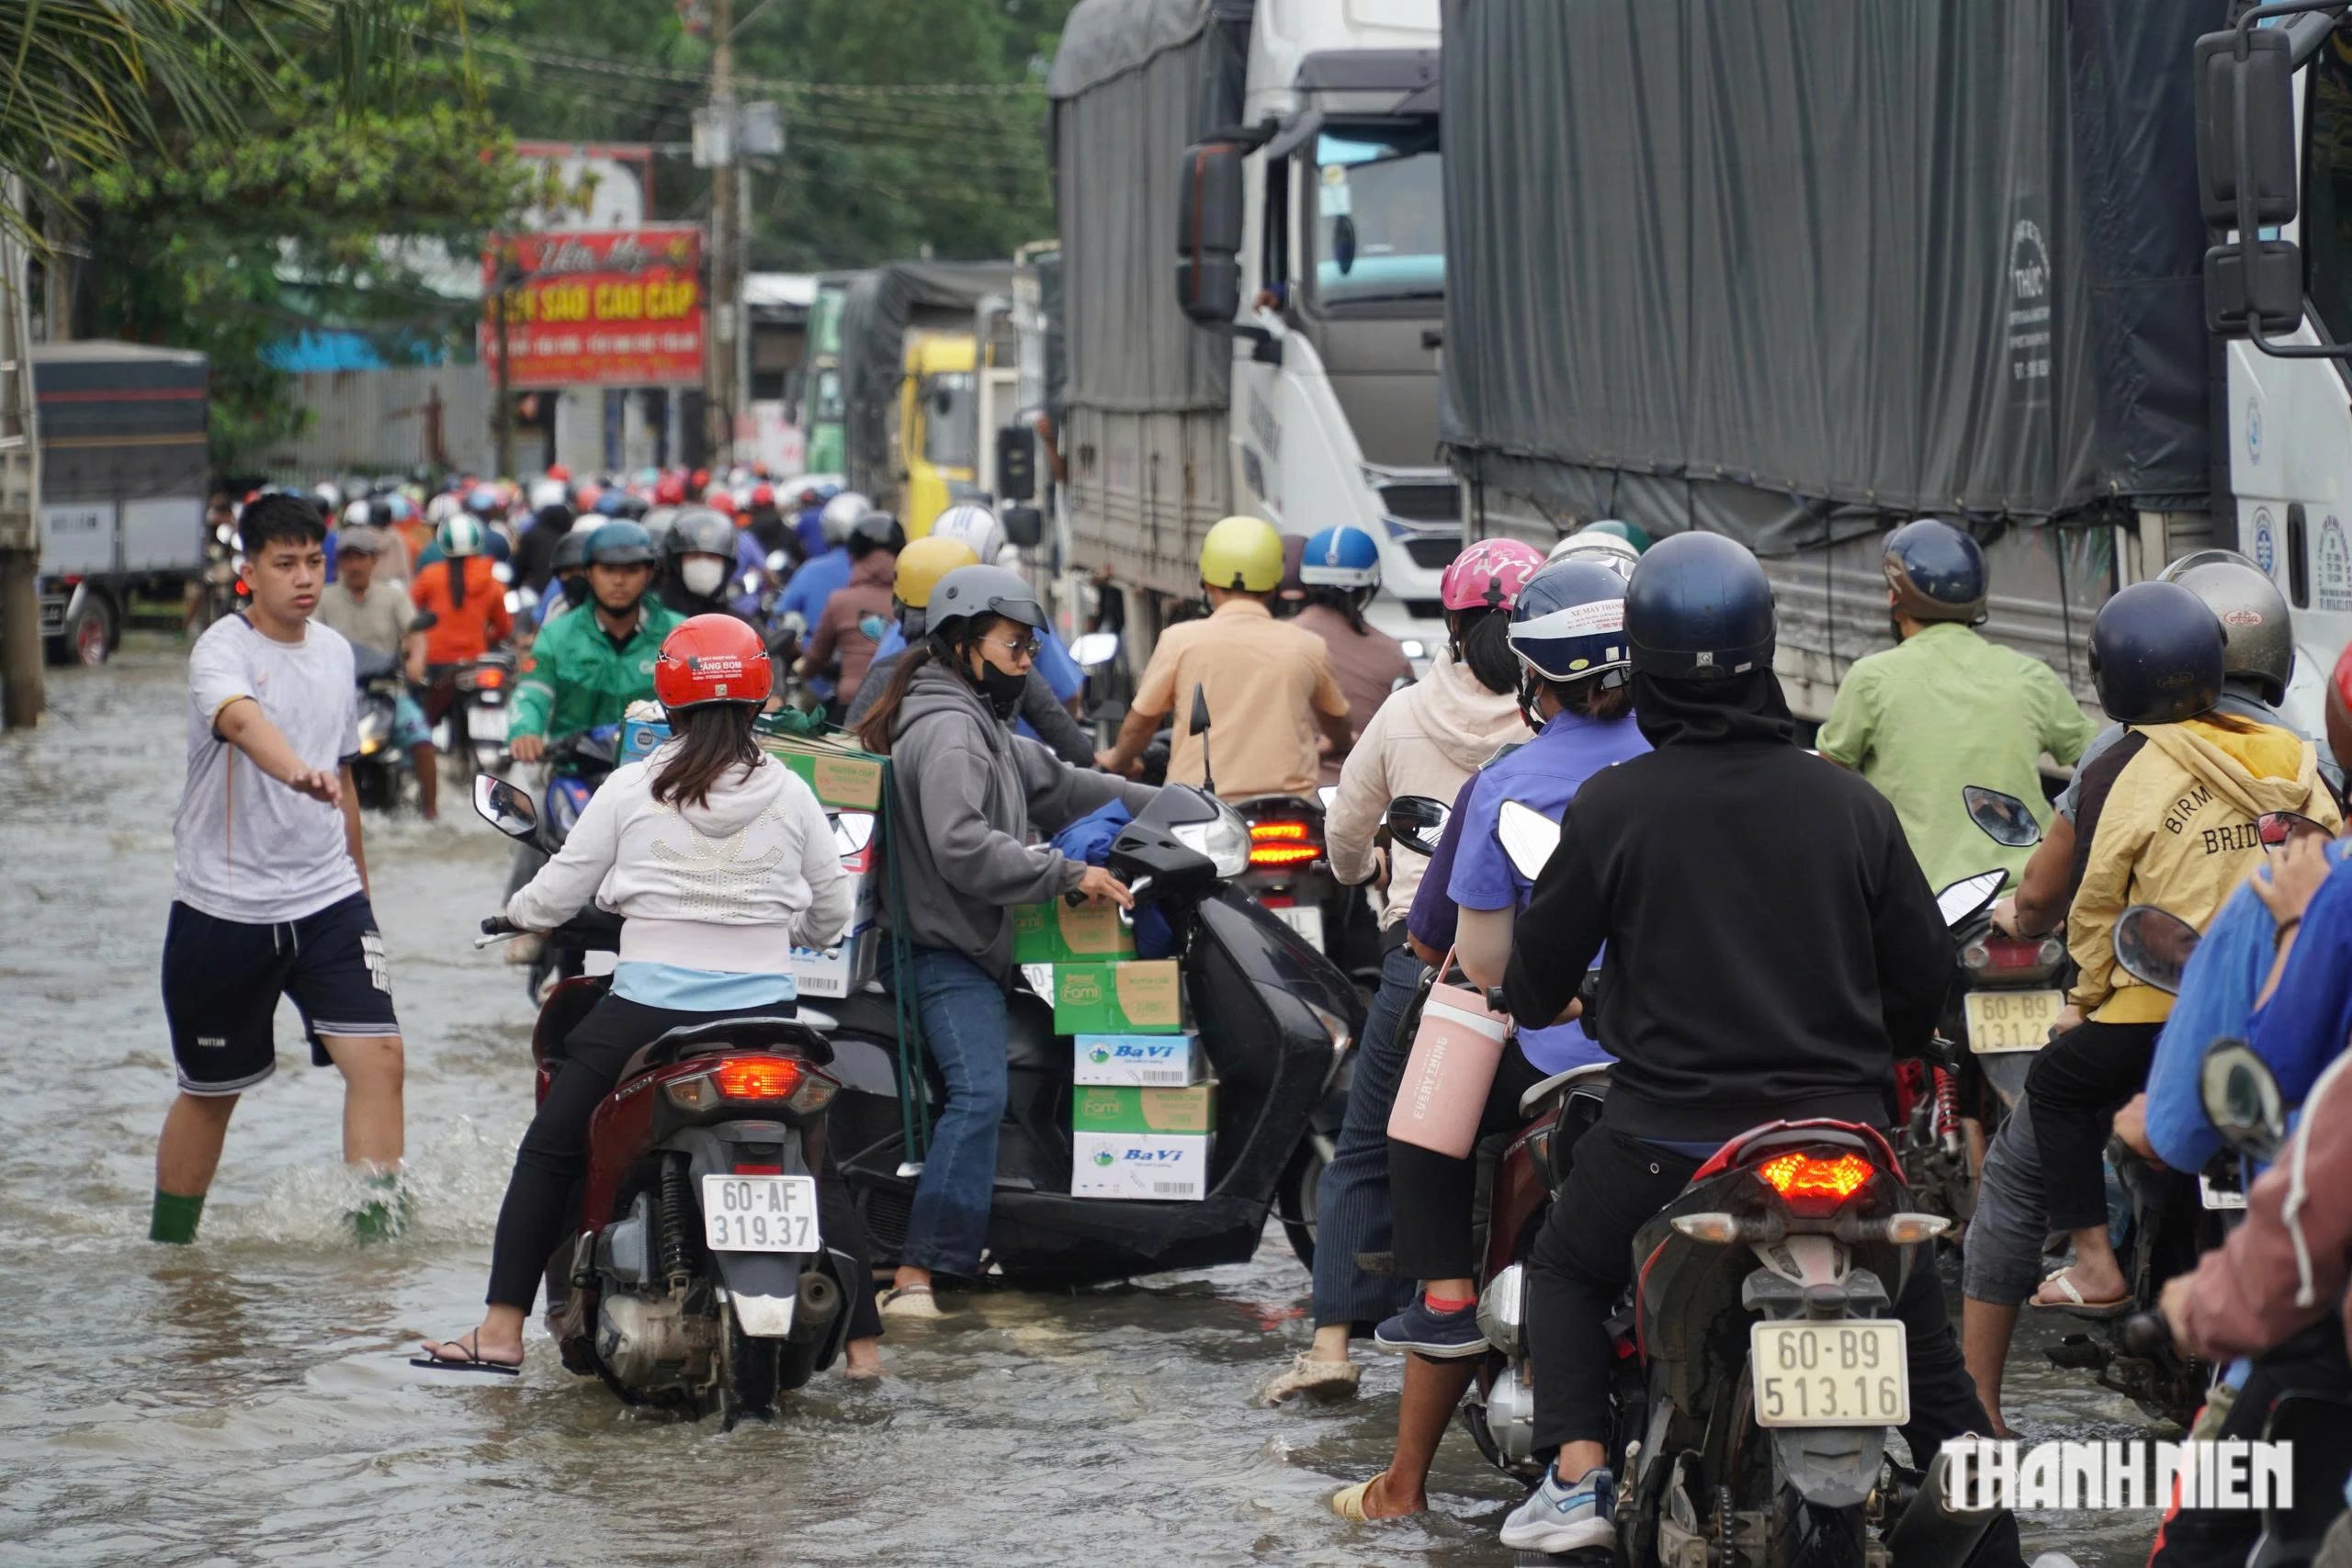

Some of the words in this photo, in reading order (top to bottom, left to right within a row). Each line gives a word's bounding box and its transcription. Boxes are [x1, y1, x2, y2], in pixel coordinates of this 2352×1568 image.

[722, 660, 742, 670] BOM
[2202, 822, 2259, 855] BRID
[1063, 986, 1101, 999] Fami
[1982, 997, 2049, 1021] 60-B9
[1413, 1078, 1435, 1120] EVERY
[722, 1181, 797, 1212] 60-AF
[713, 1214, 809, 1246] 319.37
[1778, 1330, 1880, 1370] 60-B9
[1765, 1376, 1897, 1416] 513.16
